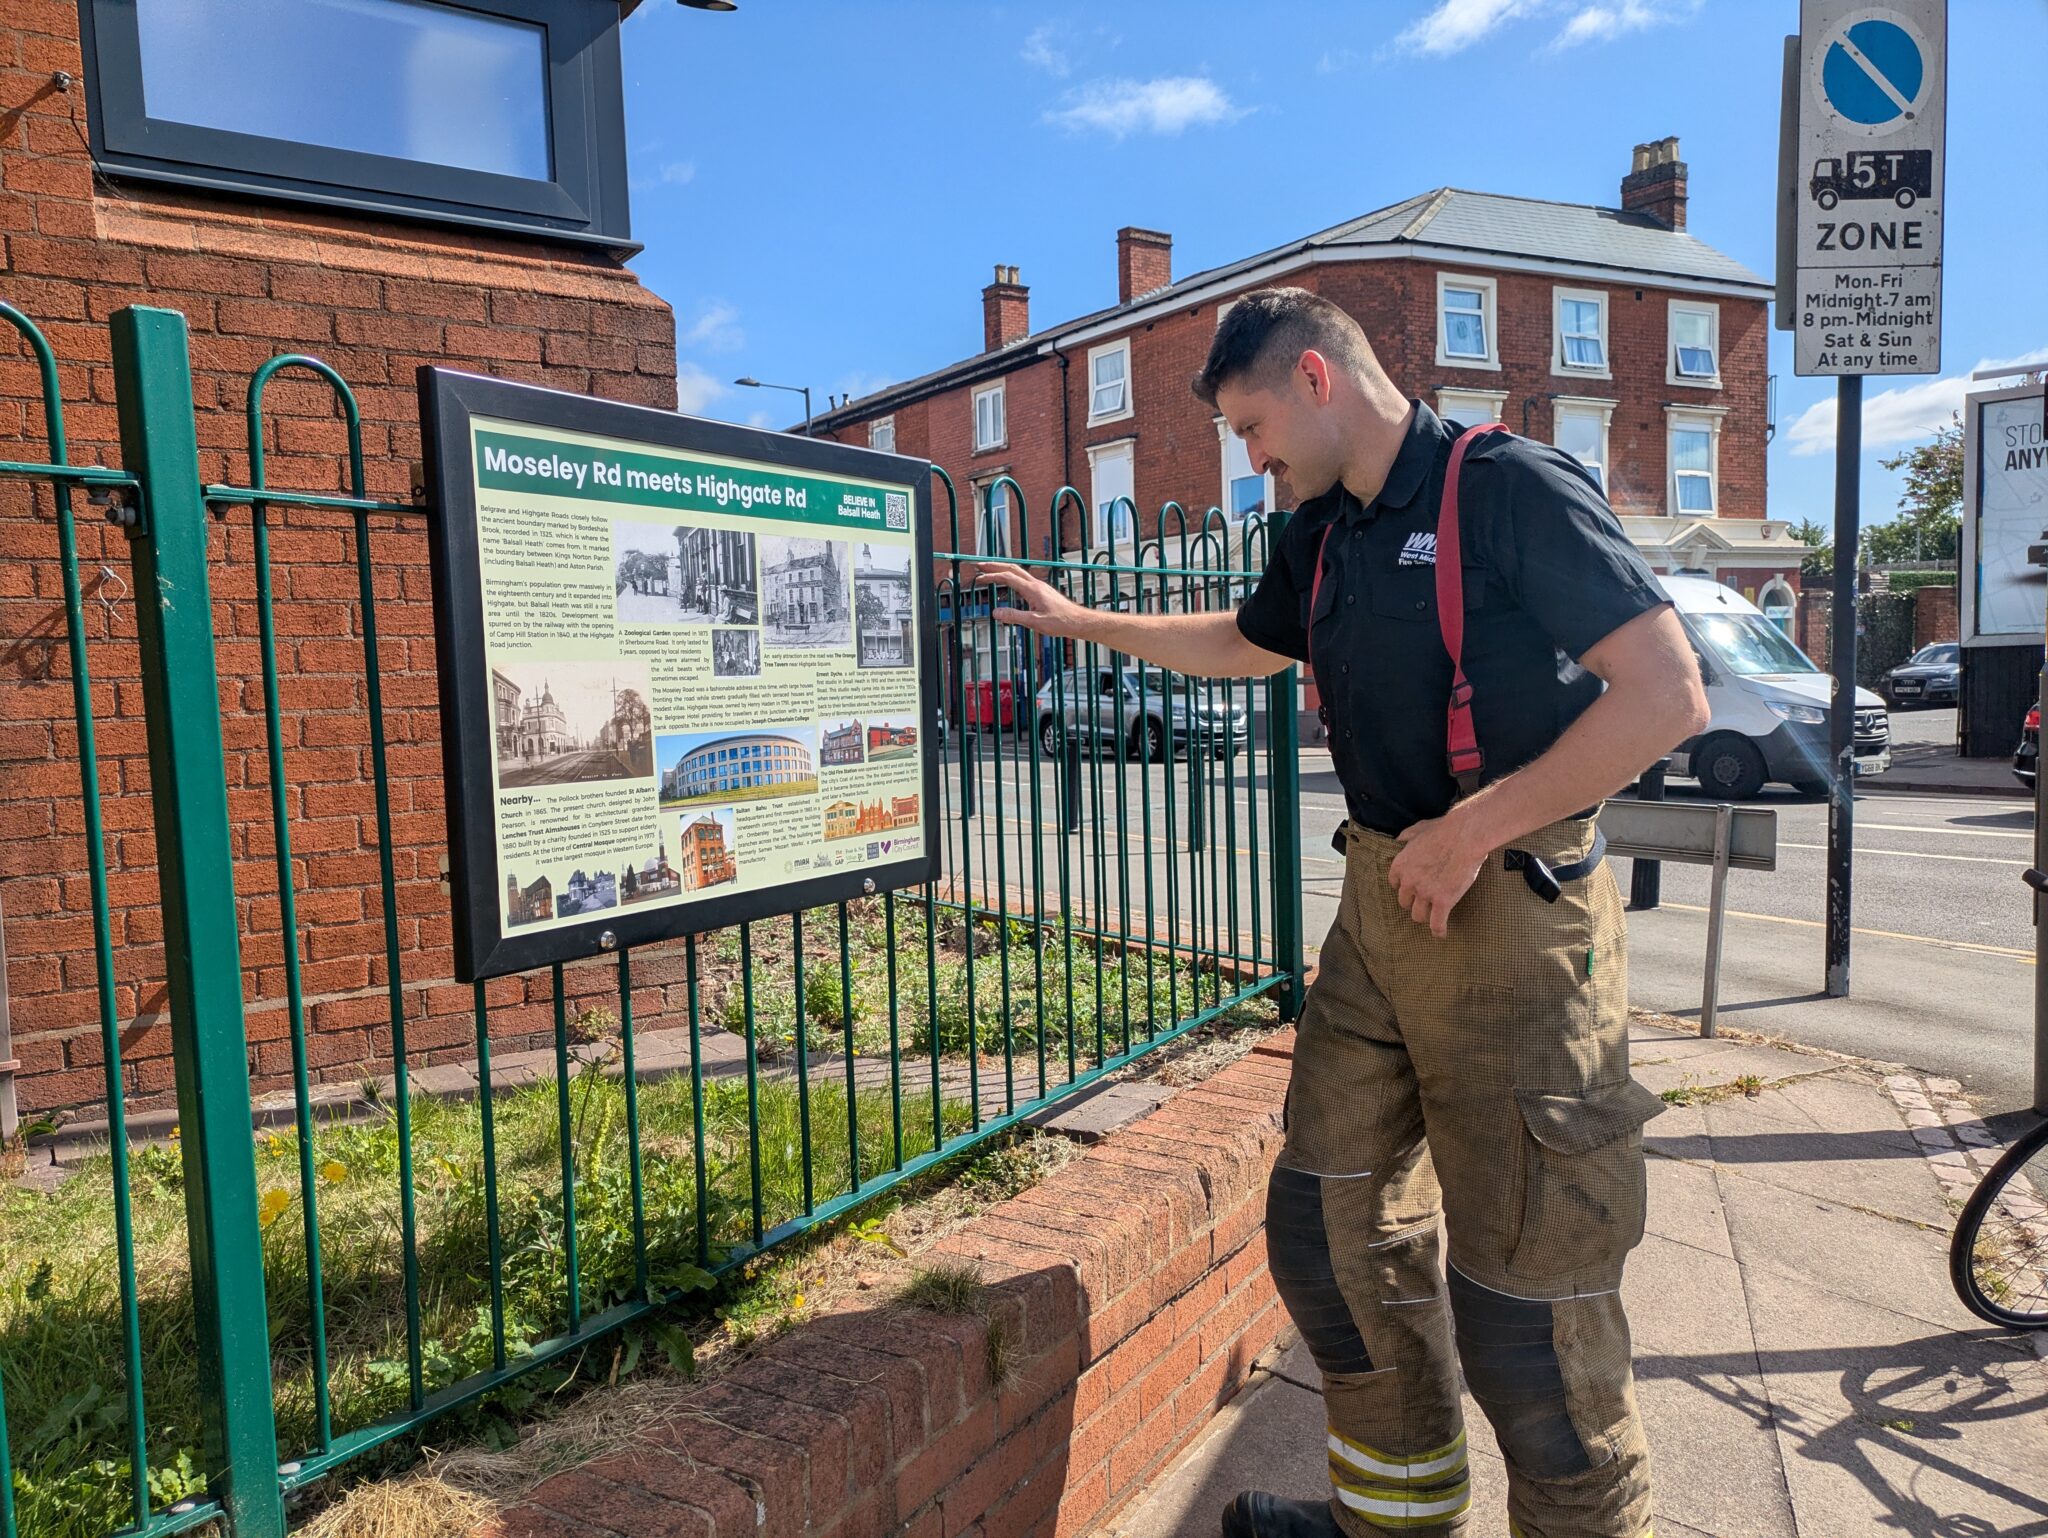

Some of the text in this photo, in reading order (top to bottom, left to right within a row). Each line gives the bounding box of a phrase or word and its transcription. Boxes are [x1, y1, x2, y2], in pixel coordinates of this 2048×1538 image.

[1816, 221, 1922, 250] ZONE
[1835, 273, 1902, 288] Mon-Fri
[1806, 292, 1930, 310] Midnight-7 am
[1803, 311, 1932, 329] 8 pm-Midnight
[1824, 332, 1912, 348] Sat & Sun
[1818, 352, 1918, 368] At any time
[2005, 422, 2046, 447] STO
[484, 447, 806, 508] Moseley Rd meets Highgate Rd
[844, 495, 876, 507] BELIEVE IN
[481, 505, 506, 516] Belgrave
[522, 509, 550, 520] Highgate
[552, 511, 569, 519] Roads
[571, 513, 590, 523] closely
[838, 504, 880, 520] Balsall Heath
[493, 516, 516, 525] ancient
[517, 518, 546, 529] boundary
[547, 521, 569, 529] marked
[570, 523, 577, 532] by
[503, 528, 530, 536] recorded
[496, 548, 525, 558] boundary
[527, 549, 553, 557] between
[555, 551, 571, 560] Kings
[486, 579, 528, 589] Birmingham's
[529, 580, 562, 590] population
[579, 582, 605, 592] massively
[498, 589, 531, 599] eighteenth
[532, 590, 554, 600] century
[573, 592, 600, 602] expanded
[562, 612, 598, 621] Development
[500, 794, 540, 806] Nearby...
[559, 794, 579, 802] Pollock
[581, 791, 604, 800] brothers
[605, 789, 627, 798] founded
[636, 786, 655, 794] Alban's
[501, 810, 523, 819] Church
[563, 803, 584, 814] present
[609, 797, 633, 808] designed
[635, 796, 641, 805] by
[502, 830, 527, 840] Lenches
[529, 828, 544, 836] Trust
[545, 823, 580, 834] Almshouses
[588, 819, 613, 830] Conybere
[615, 817, 630, 825] Street
[644, 813, 656, 821] from
[552, 845, 565, 853] time
[572, 840, 593, 850] Central
[594, 837, 615, 849] Mosque
[616, 834, 637, 846] opening
